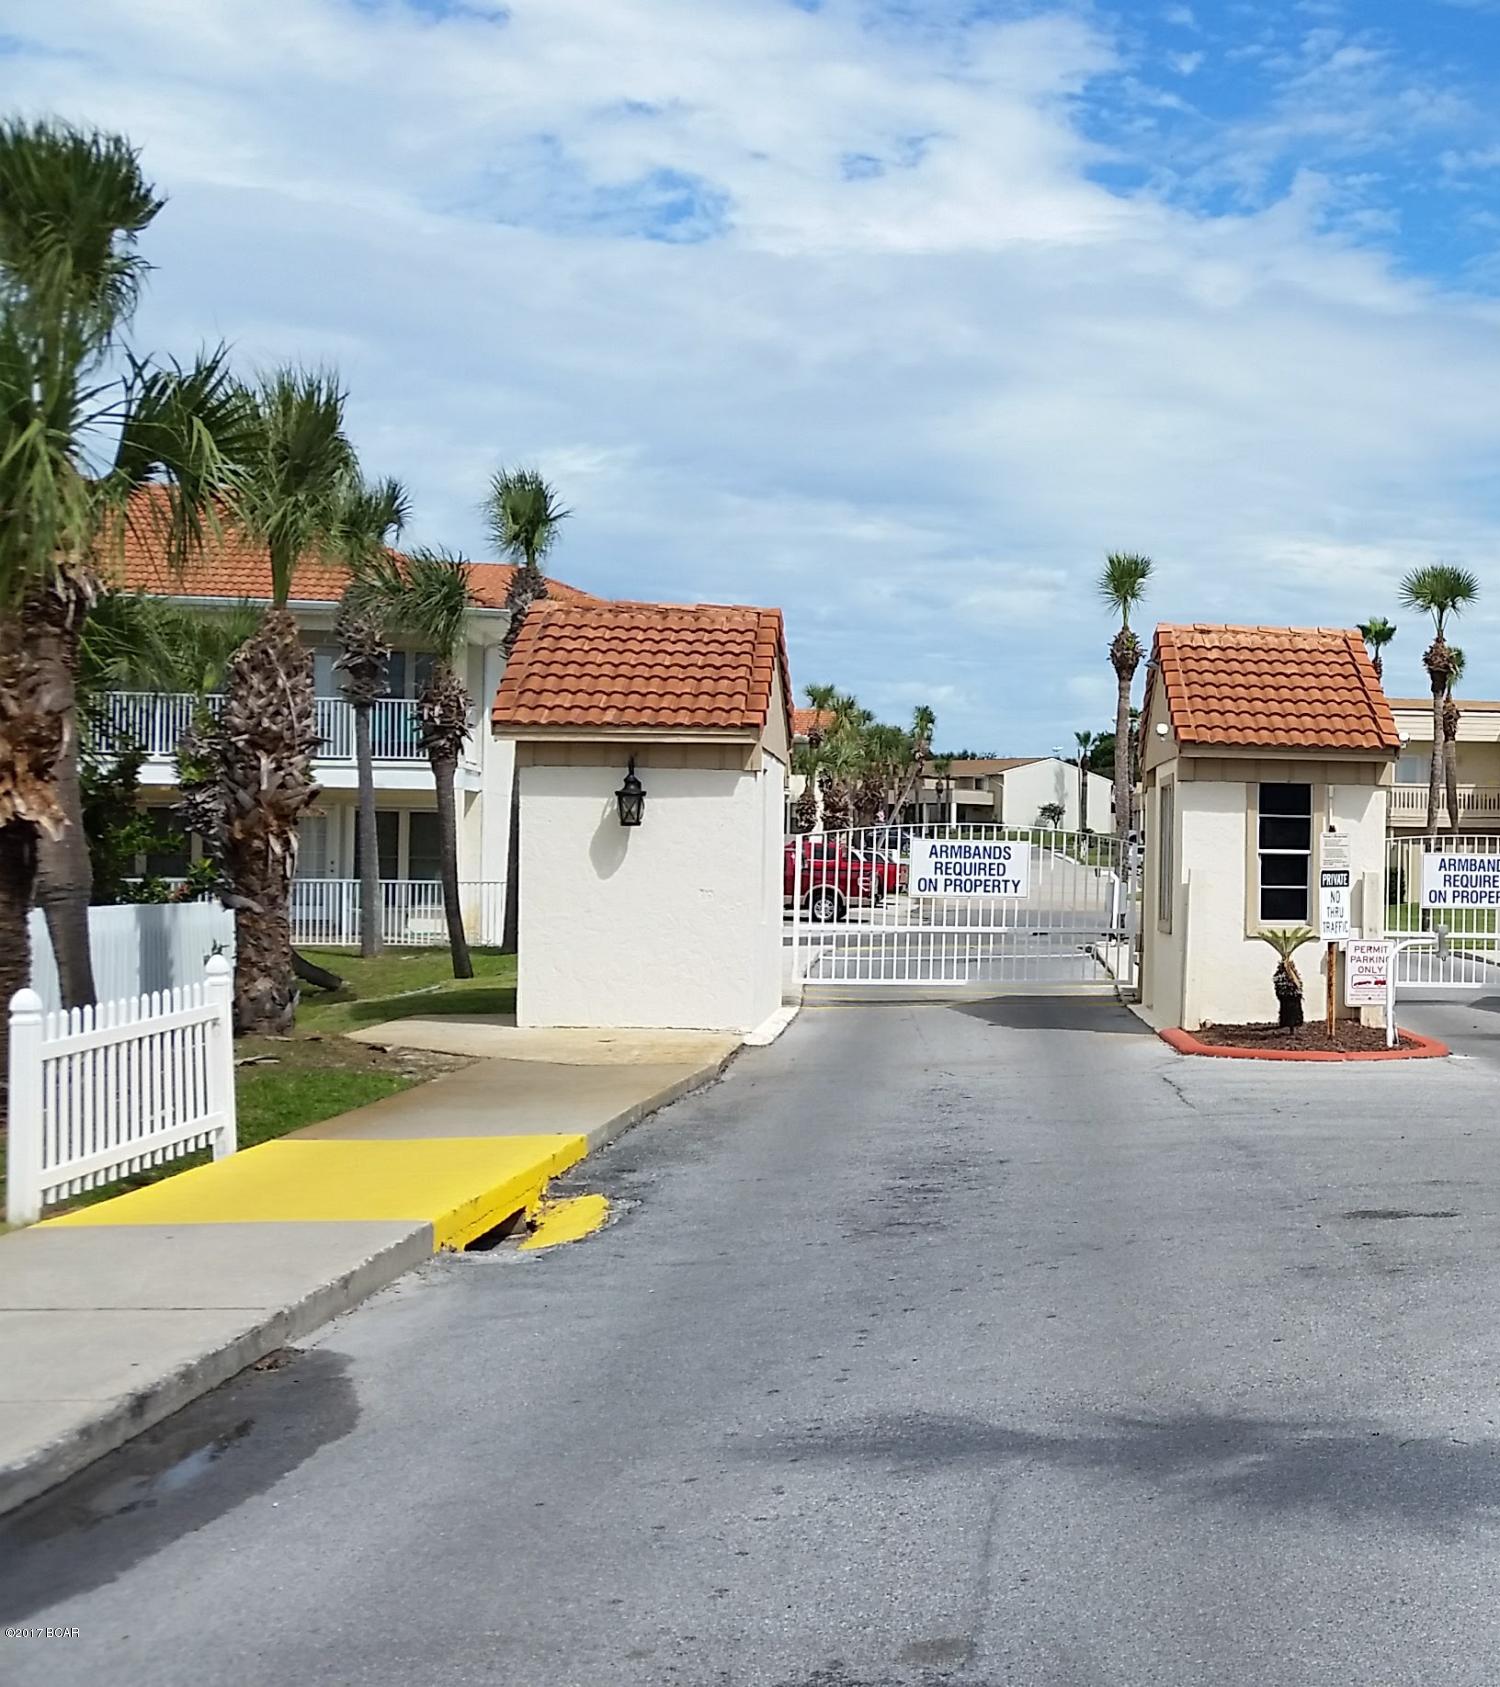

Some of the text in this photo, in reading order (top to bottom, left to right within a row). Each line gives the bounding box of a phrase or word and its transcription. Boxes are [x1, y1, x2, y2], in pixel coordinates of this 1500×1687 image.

[929, 844, 1012, 861] ARMBANDS
[934, 861, 1006, 877] REQUIRED
[917, 877, 1021, 894] ON PROPERTY
[1322, 873, 1348, 887] PRIVATE
[1330, 890, 1341, 904] NO
[1429, 889, 1447, 904] ON
[1327, 906, 1344, 918] THRU
[1323, 920, 1349, 934] TRAFFIC
[1354, 945, 1389, 954] PERMIT
[1357, 965, 1383, 974] ONLY
